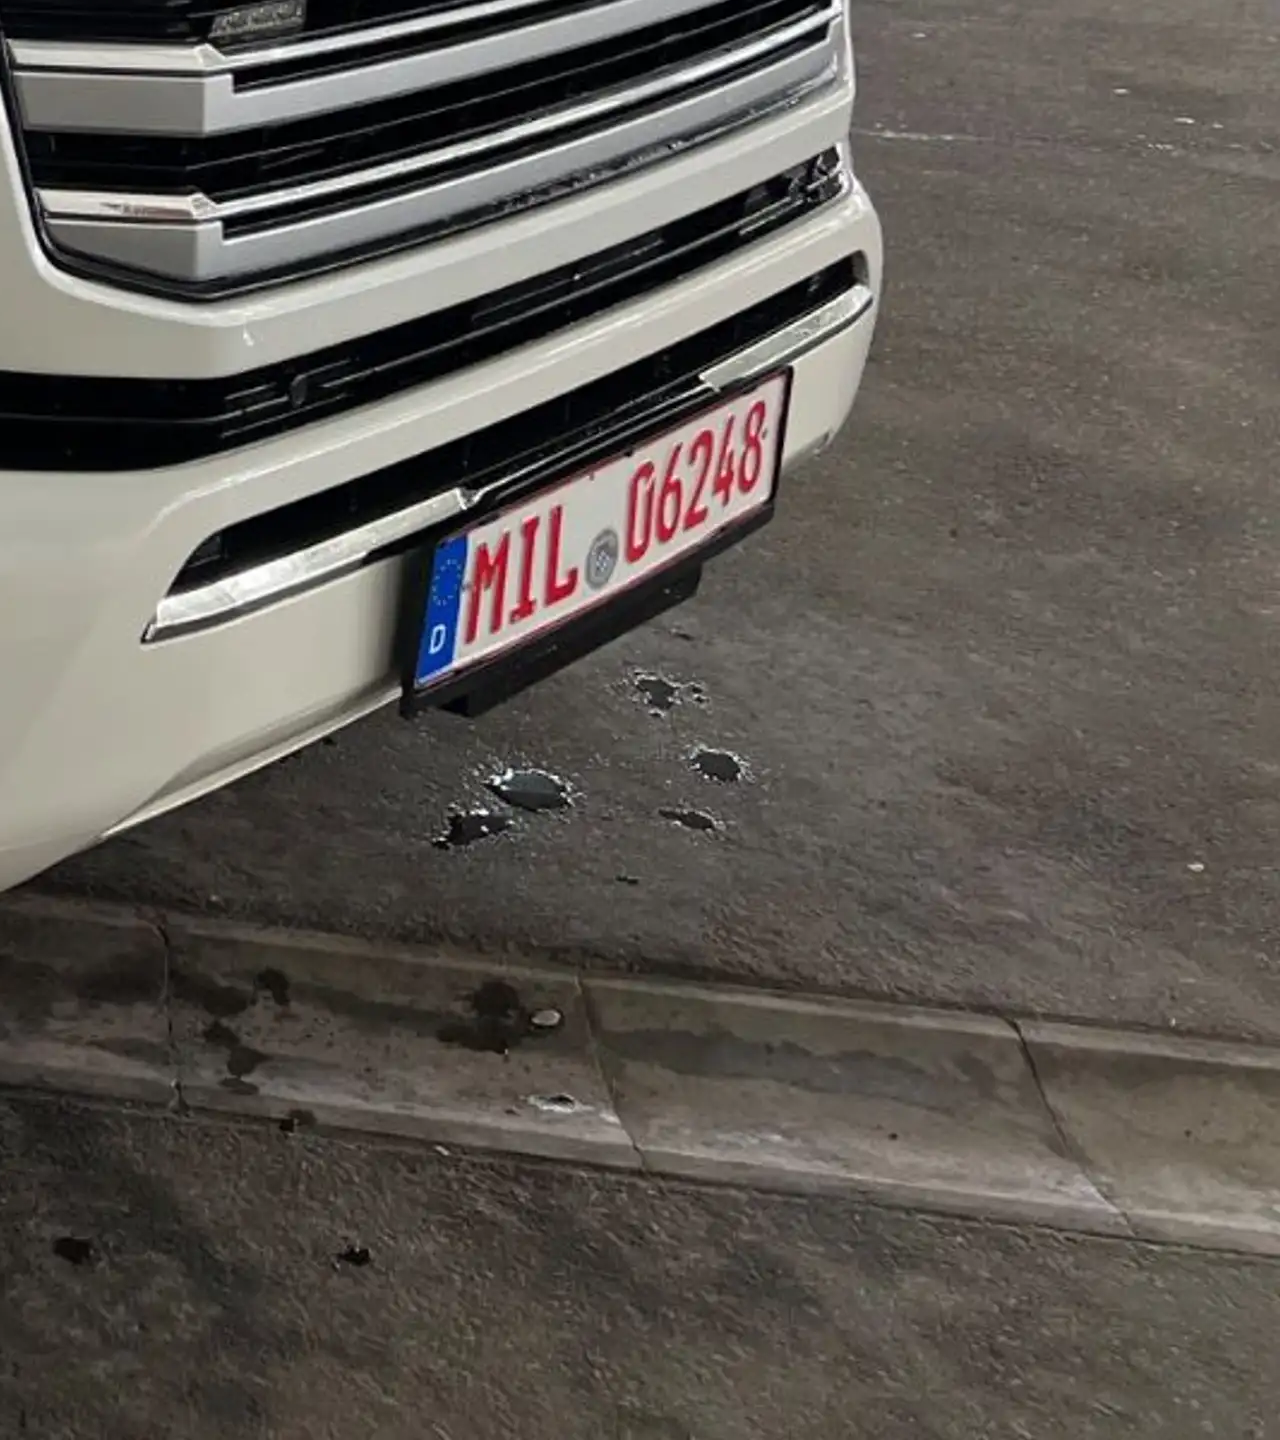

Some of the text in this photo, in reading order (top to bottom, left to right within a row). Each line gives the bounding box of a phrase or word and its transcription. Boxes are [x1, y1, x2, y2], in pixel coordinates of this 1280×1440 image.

[464, 398, 767, 645] MIL 06248
[427, 623, 446, 654] D
